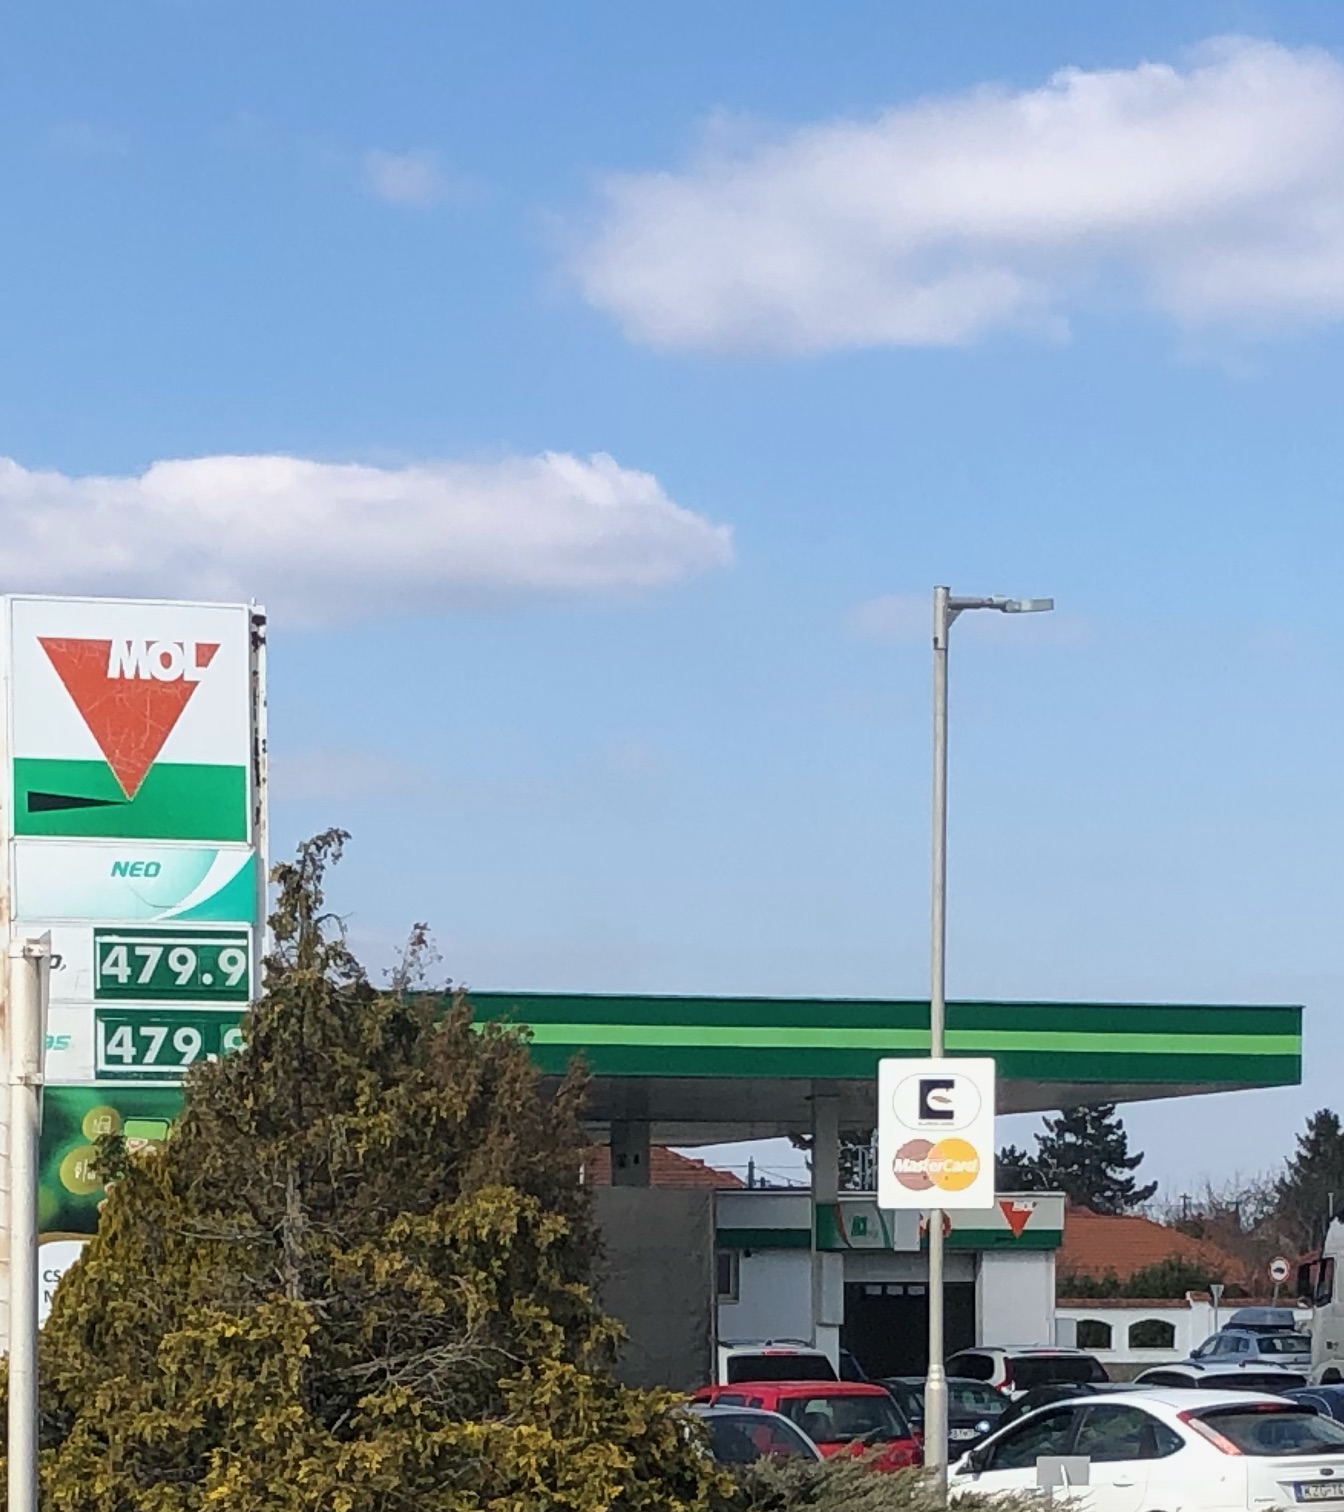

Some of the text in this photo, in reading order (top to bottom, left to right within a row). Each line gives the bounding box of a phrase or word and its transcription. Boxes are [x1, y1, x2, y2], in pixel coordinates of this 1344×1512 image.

[107, 640, 209, 682] MOL
[111, 861, 162, 878] NEO
[101, 945, 247, 986] 479.9
